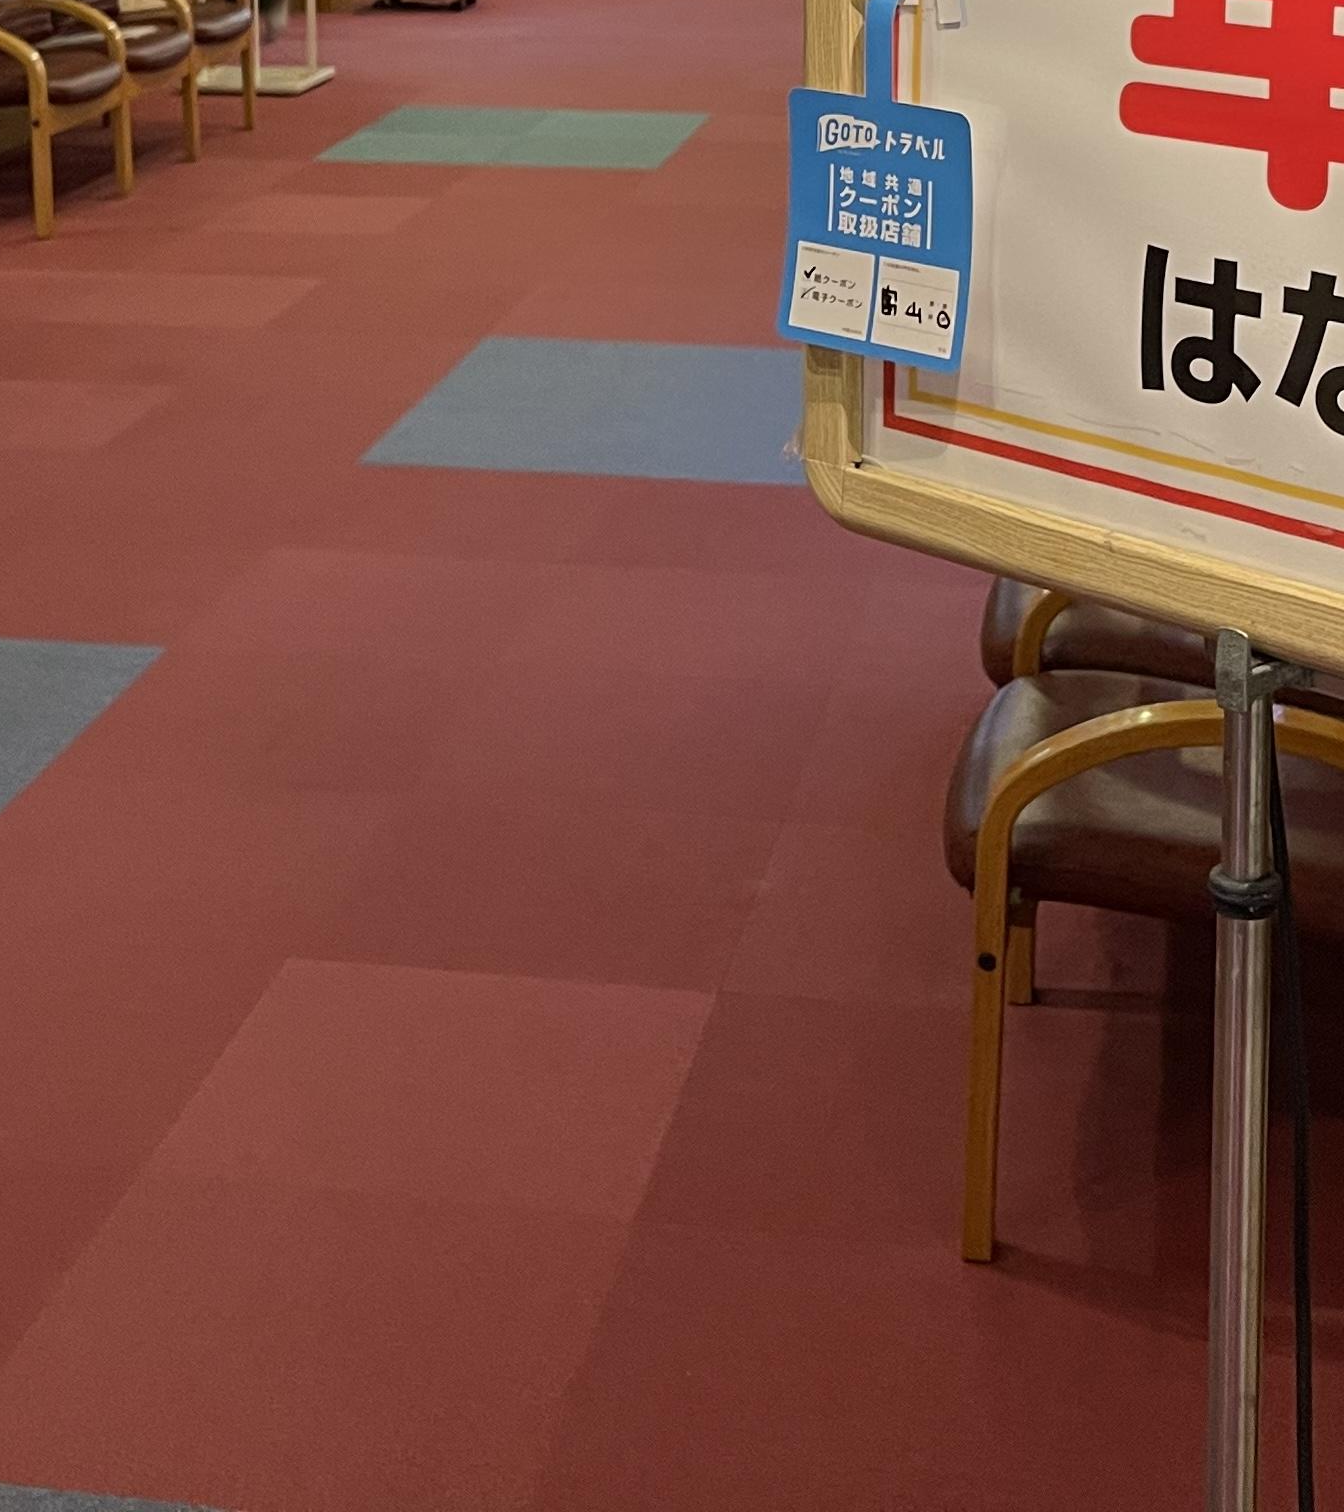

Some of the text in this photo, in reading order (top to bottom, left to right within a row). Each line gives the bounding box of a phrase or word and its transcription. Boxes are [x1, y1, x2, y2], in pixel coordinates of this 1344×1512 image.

[884, 130, 946, 161] トラベル
[839, 166, 922, 197] 地域共通
[839, 186, 922, 219] クーポン
[837, 210, 922, 249] 取扱店舗
